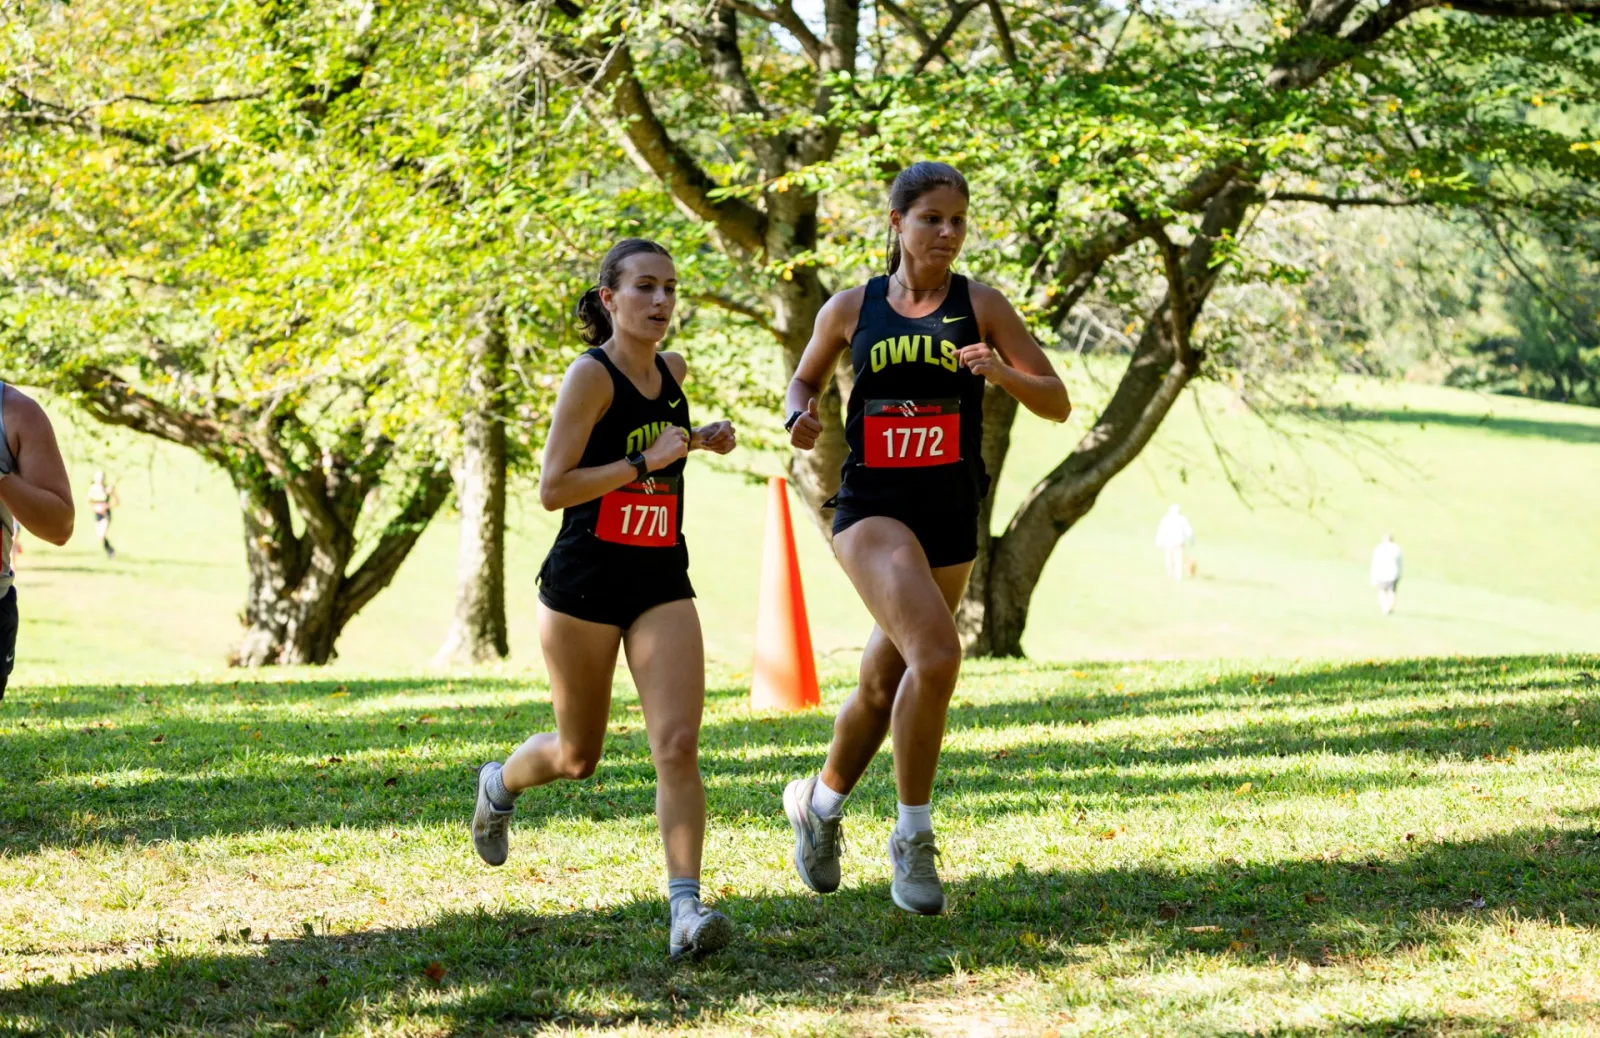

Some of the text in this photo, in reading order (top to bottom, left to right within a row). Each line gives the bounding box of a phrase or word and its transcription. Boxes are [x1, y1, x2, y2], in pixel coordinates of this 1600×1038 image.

[870, 335, 958, 373] OWLS
[626, 421, 690, 456] OW
[882, 426, 944, 458] 1772
[620, 504, 668, 537] 1770
